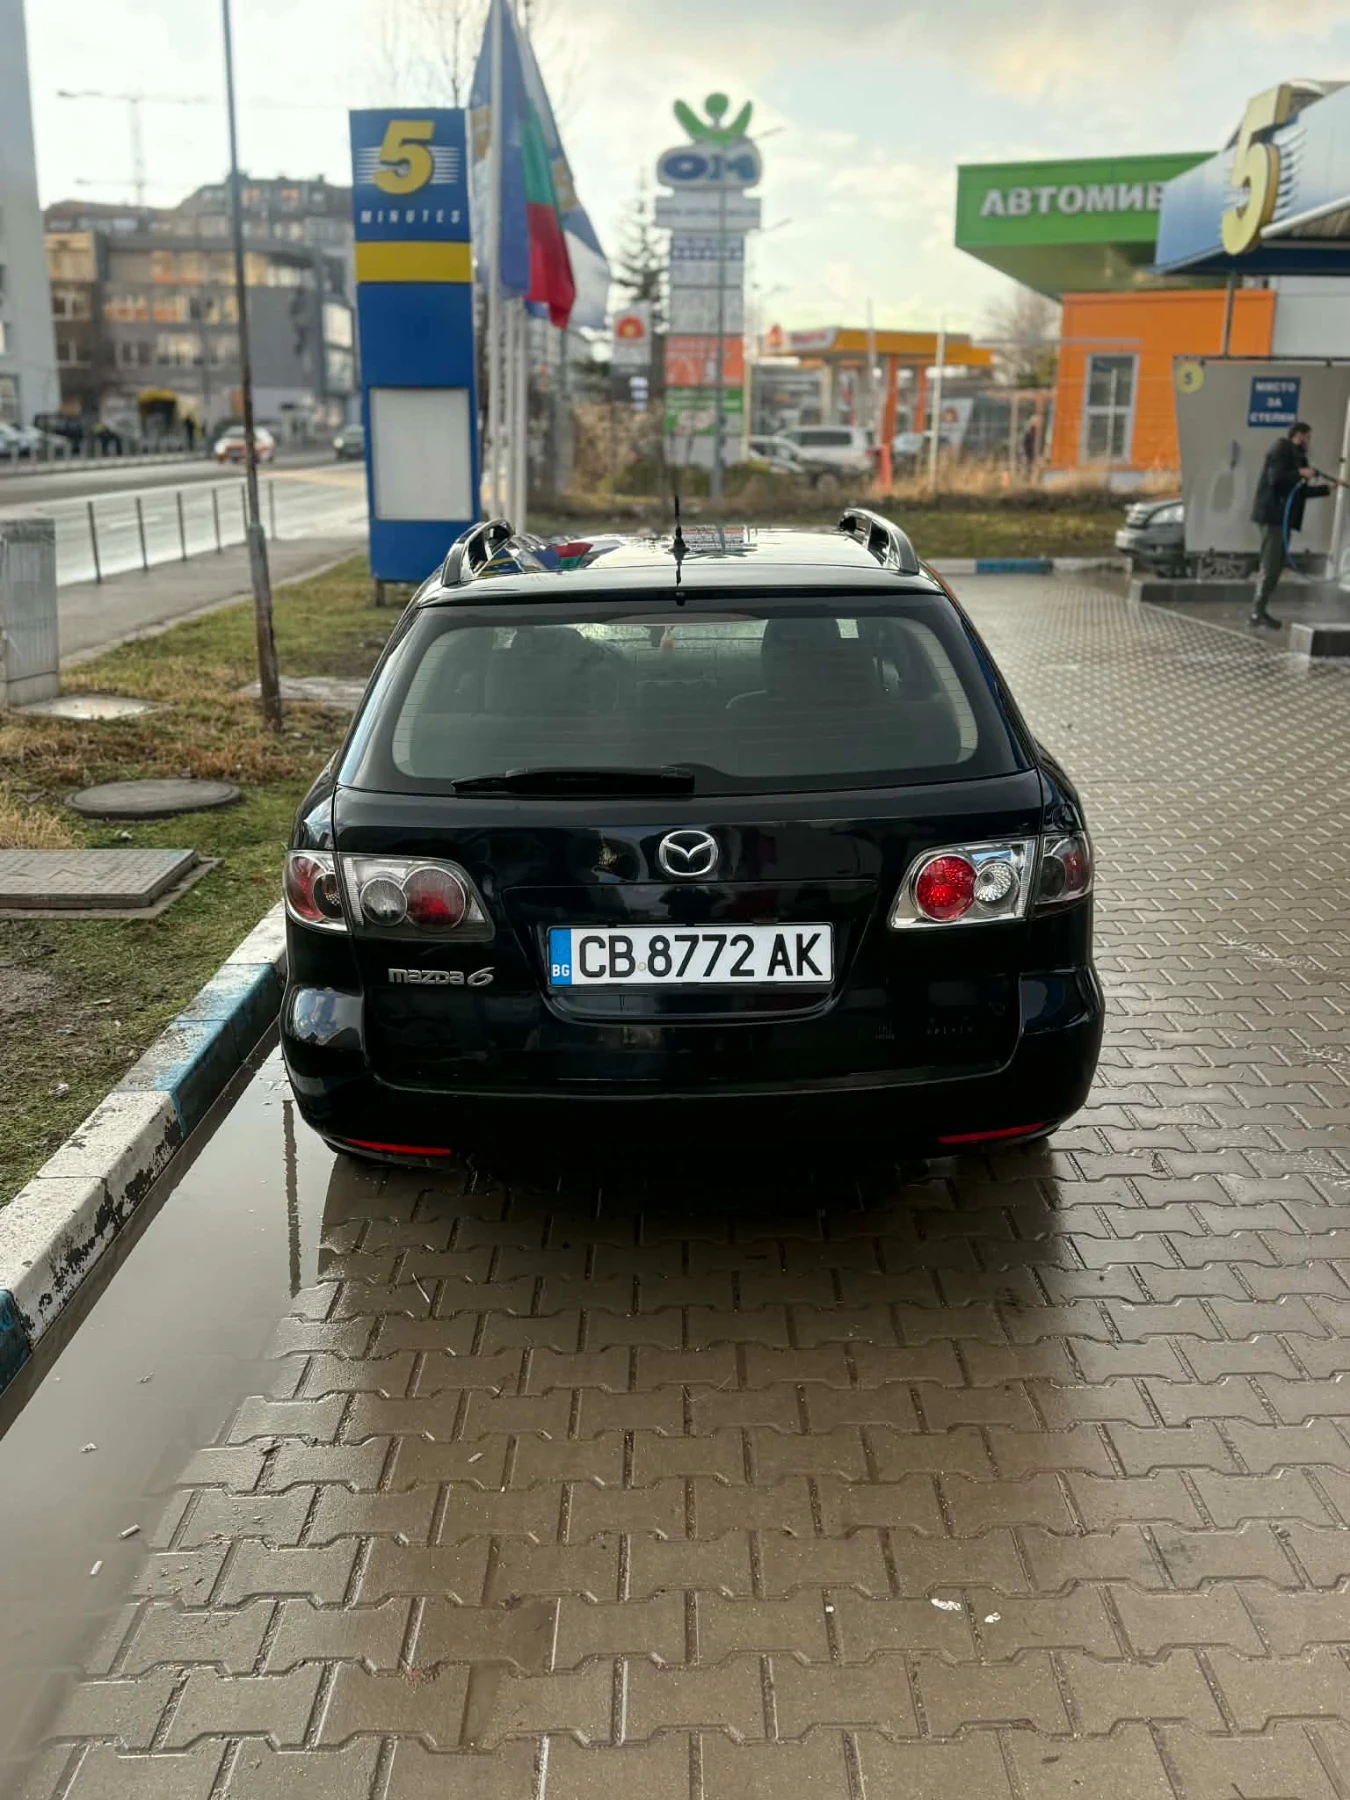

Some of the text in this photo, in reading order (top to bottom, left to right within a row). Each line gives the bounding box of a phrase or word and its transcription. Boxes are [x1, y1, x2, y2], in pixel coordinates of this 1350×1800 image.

[373, 119, 435, 195] 5
[1221, 83, 1292, 255] 5
[361, 209, 461, 224] MINUTES
[1265, 397, 1283, 408] ЗА
[579, 932, 823, 978] CB 8772 AK
[551, 965, 571, 977] BG
